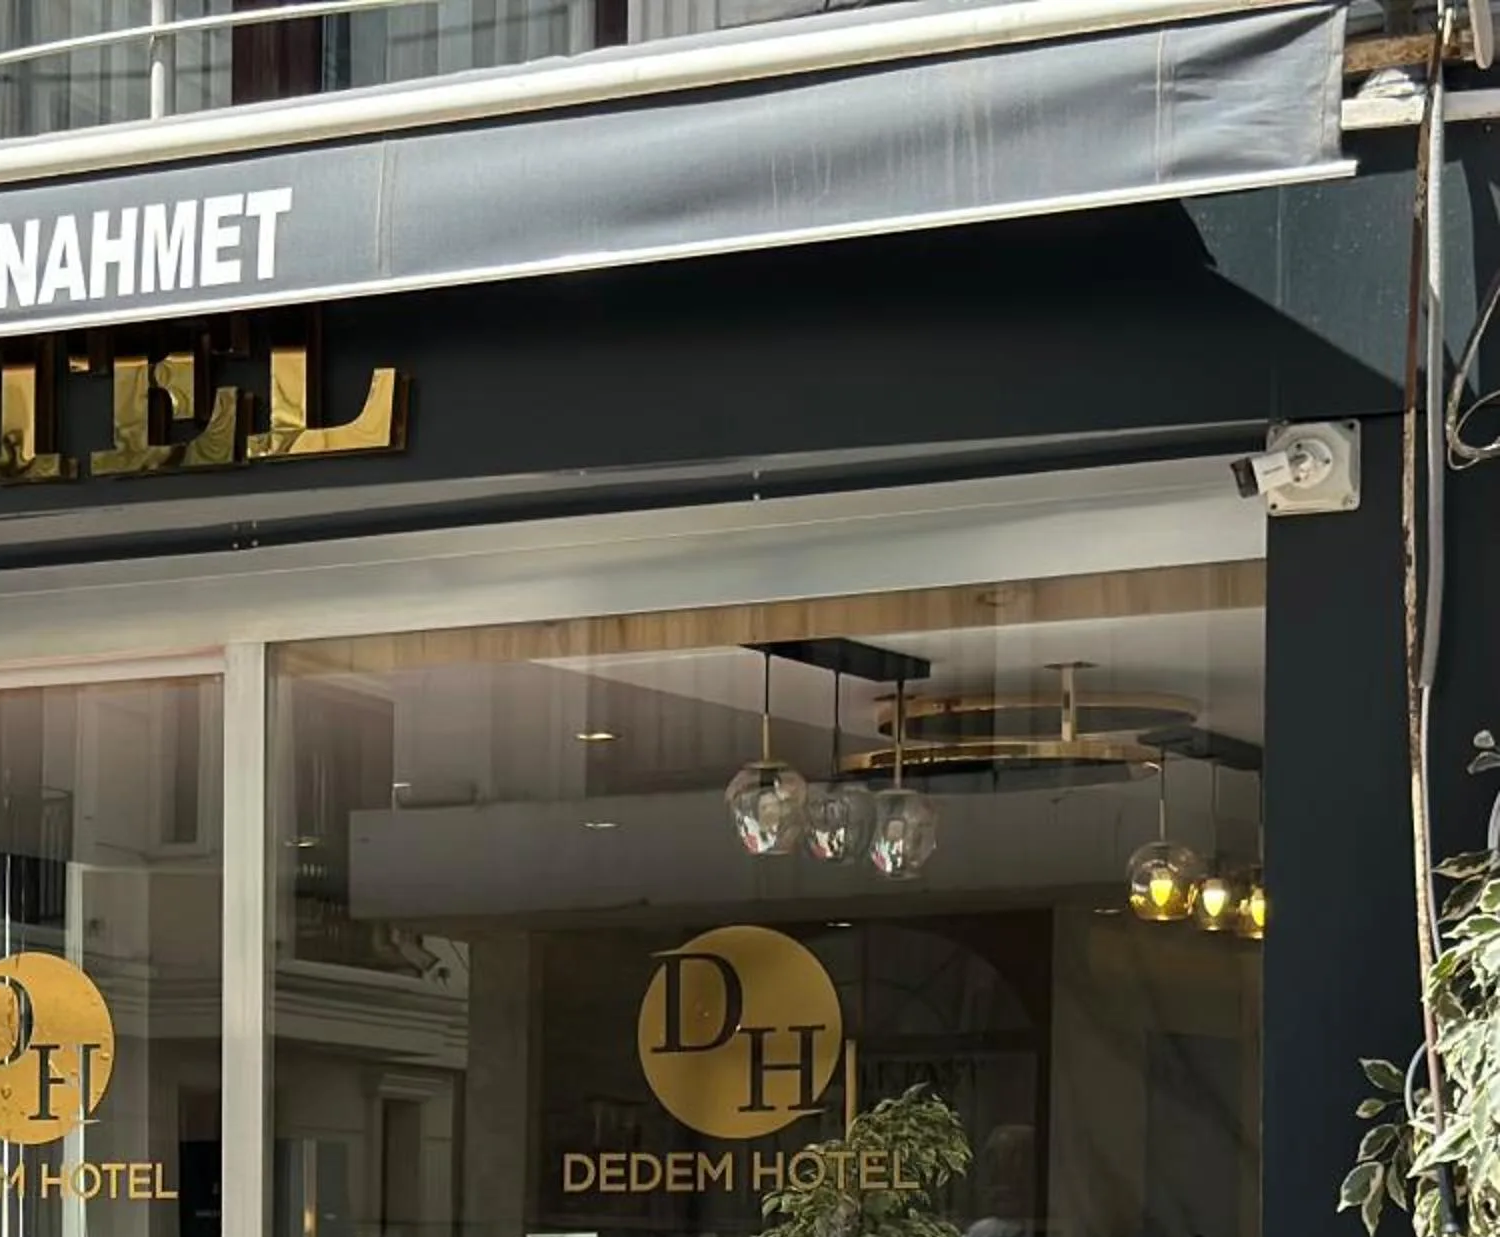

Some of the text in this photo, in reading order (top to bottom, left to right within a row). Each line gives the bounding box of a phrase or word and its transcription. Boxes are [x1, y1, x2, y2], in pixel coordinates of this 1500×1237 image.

[41, 1162, 179, 1200] HOTEL
[563, 1151, 921, 1192] DEDEM HOTEL
